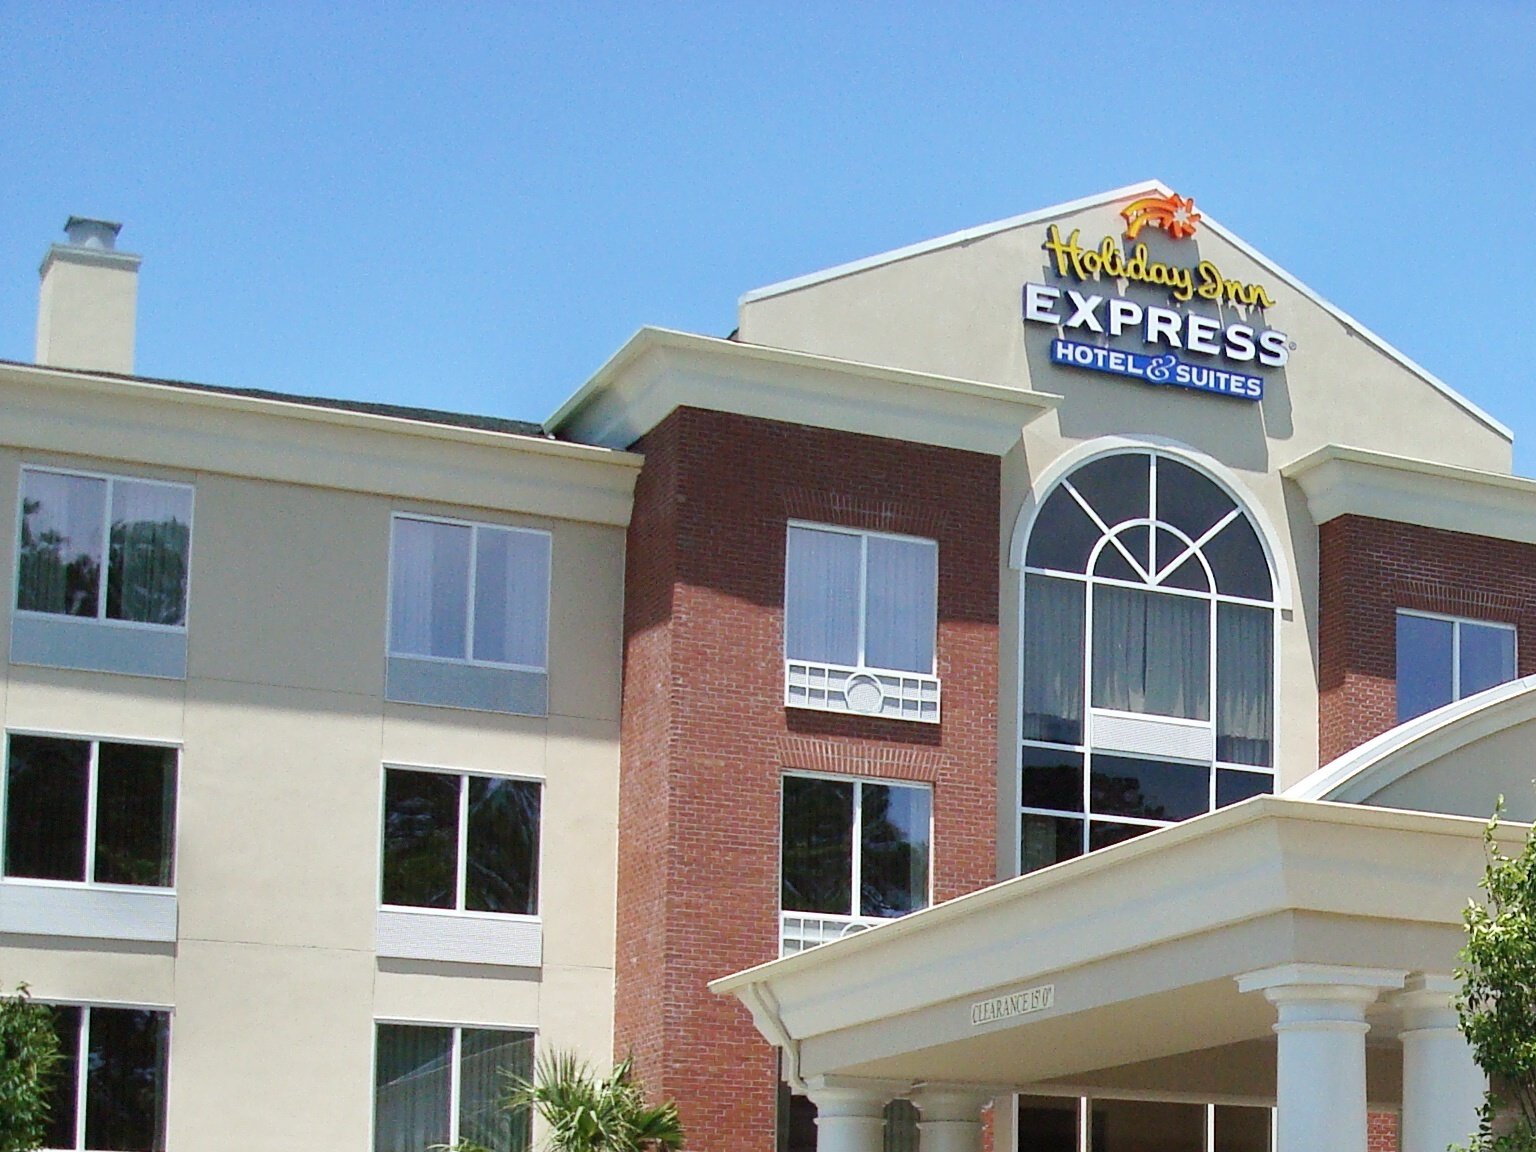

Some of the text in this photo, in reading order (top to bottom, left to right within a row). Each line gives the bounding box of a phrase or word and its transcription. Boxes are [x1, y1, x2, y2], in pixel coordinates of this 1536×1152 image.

[1042, 224, 1276, 307] Holiday Inn
[1023, 282, 1290, 368] EXPRESS
[1056, 342, 1261, 397] HOTEL & SUITES
